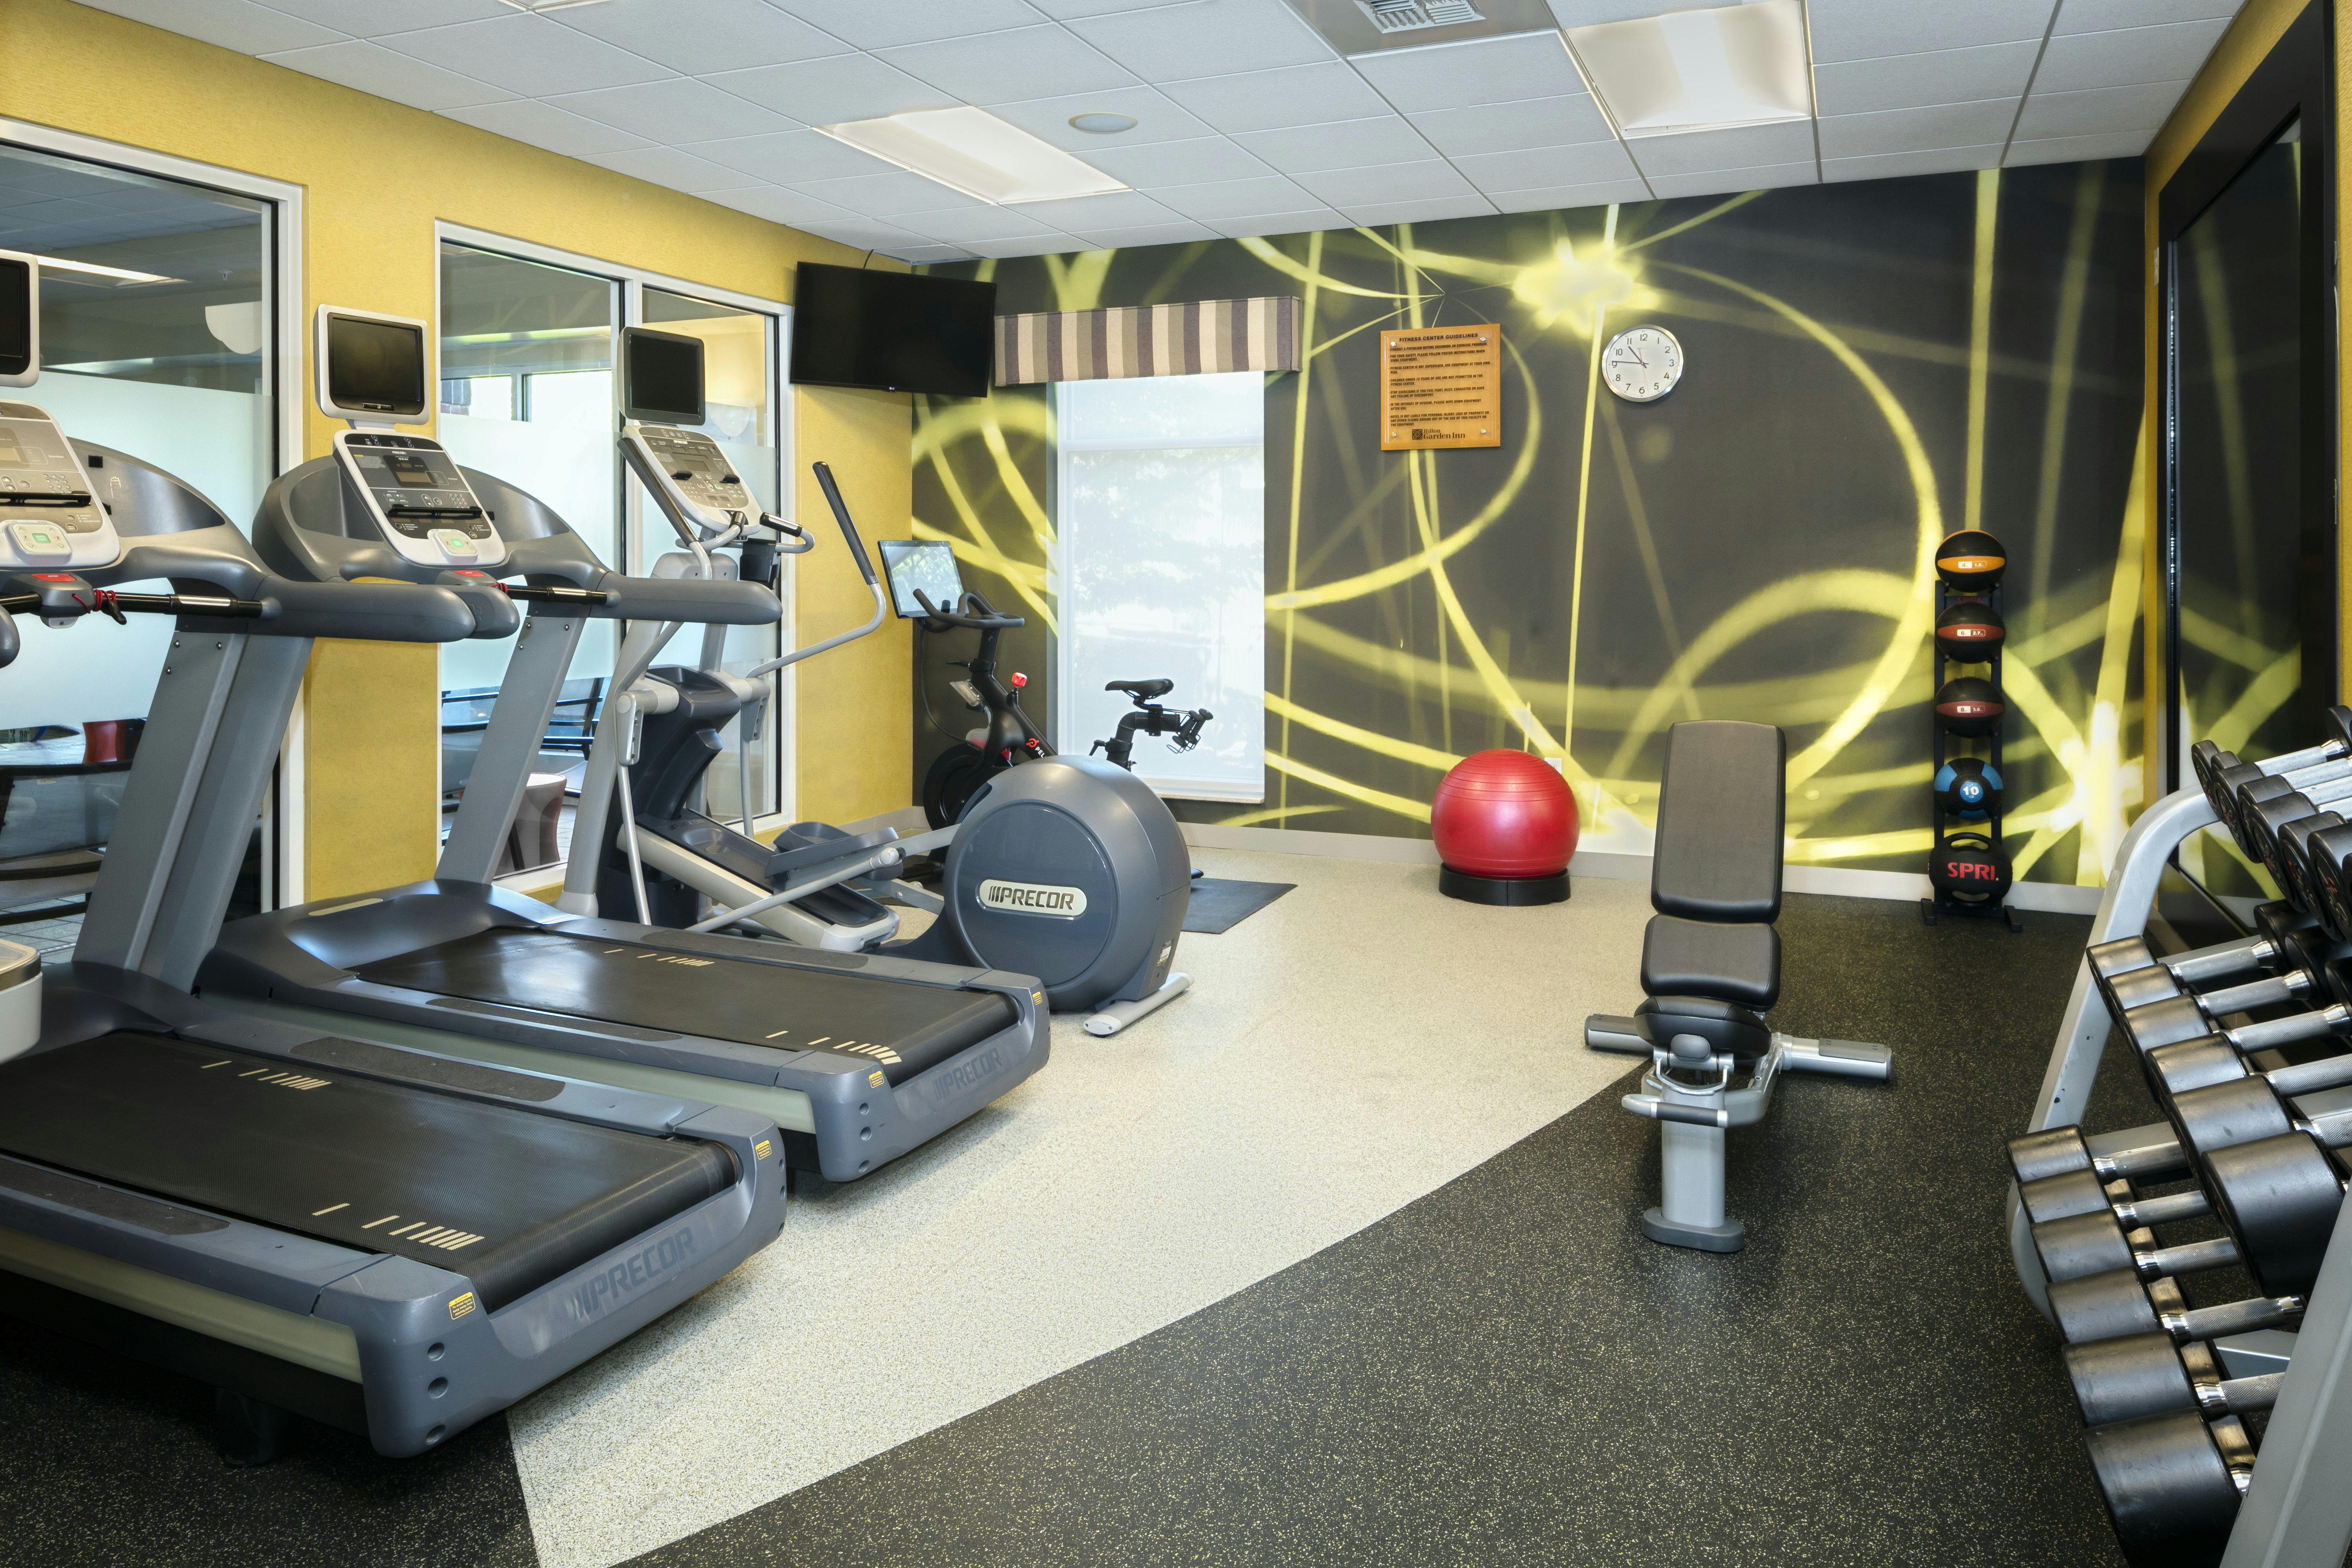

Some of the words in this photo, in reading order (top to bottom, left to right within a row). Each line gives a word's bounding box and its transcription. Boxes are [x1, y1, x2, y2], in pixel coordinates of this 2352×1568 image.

[1035, 746, 1045, 758] PEL
[1963, 786, 1979, 795] 10
[1948, 862, 1995, 880] SPRI
[999, 887, 1075, 910] PRECOR
[943, 1048, 1003, 1097] PRECOR
[589, 1227, 697, 1310] PRECOR
